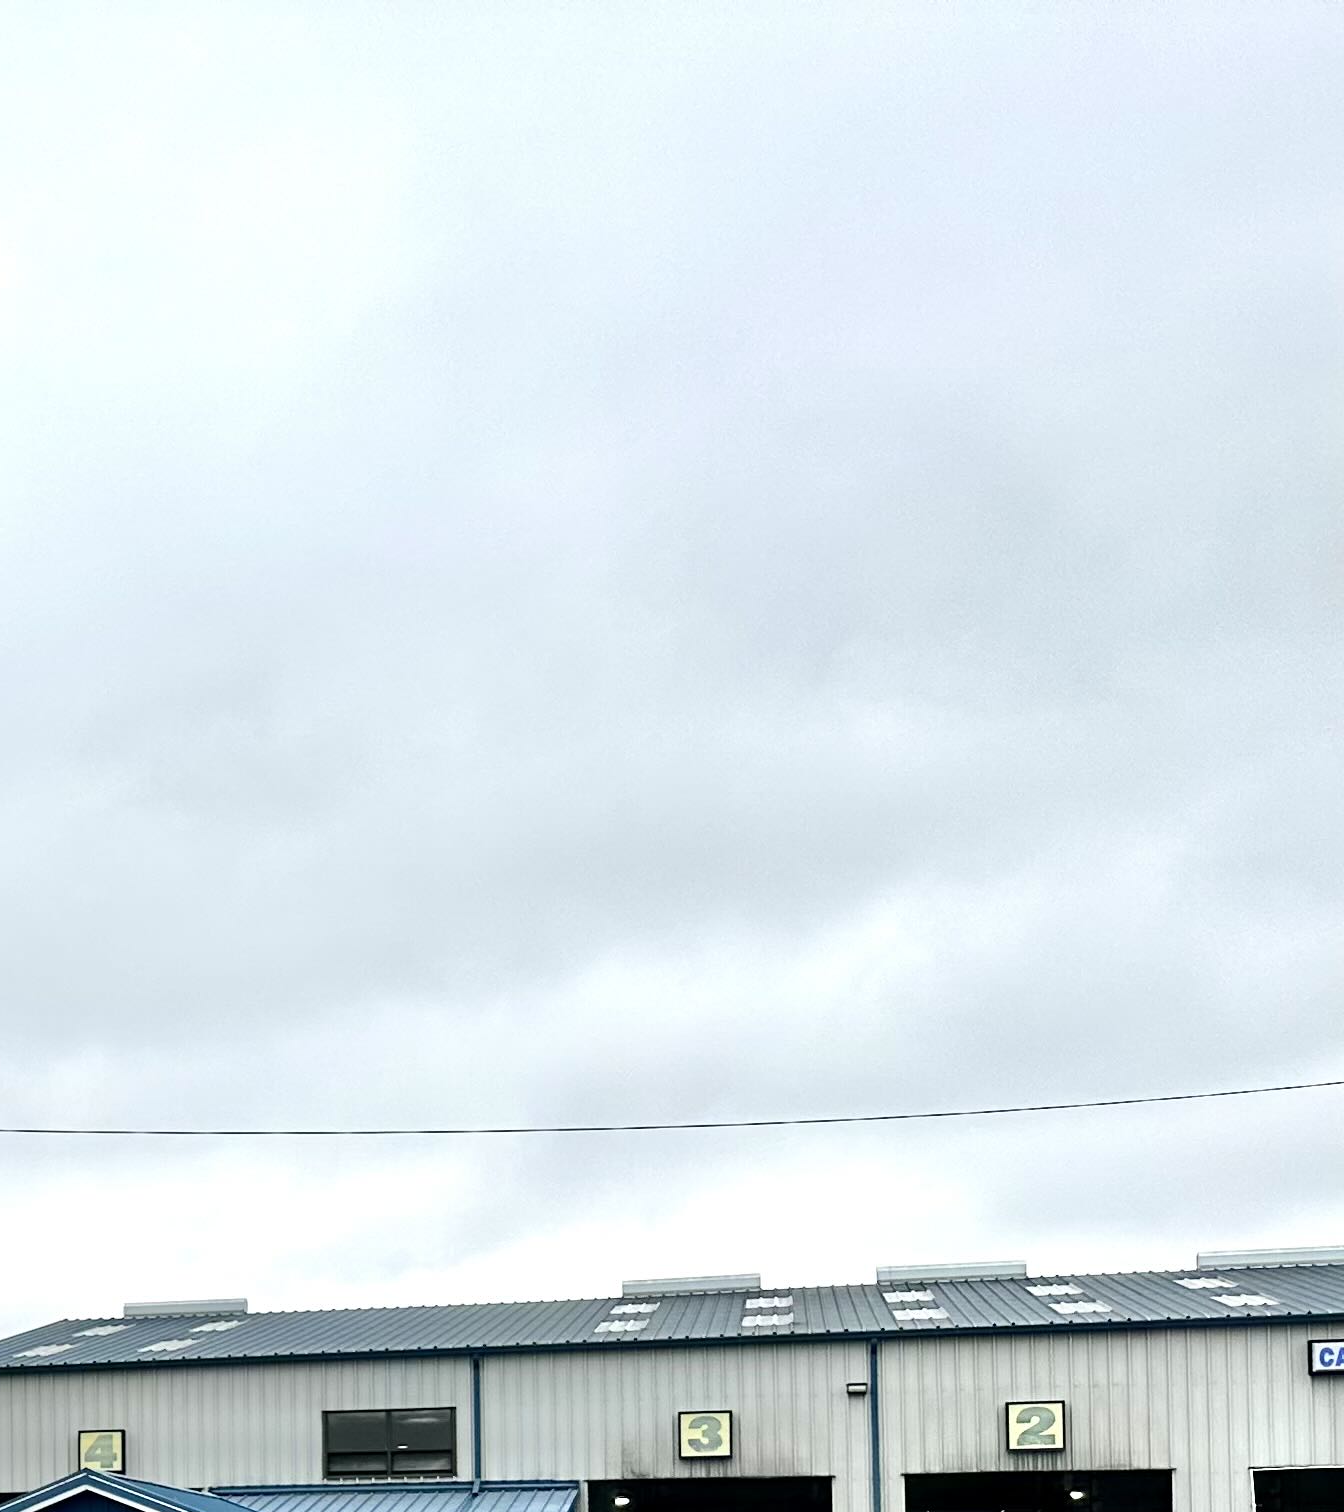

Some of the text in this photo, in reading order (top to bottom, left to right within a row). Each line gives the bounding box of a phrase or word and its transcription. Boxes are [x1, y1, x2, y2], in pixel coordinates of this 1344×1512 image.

[688, 1415, 723, 1453] 3
[1016, 1406, 1056, 1445] 2
[84, 1434, 117, 1468] 4
